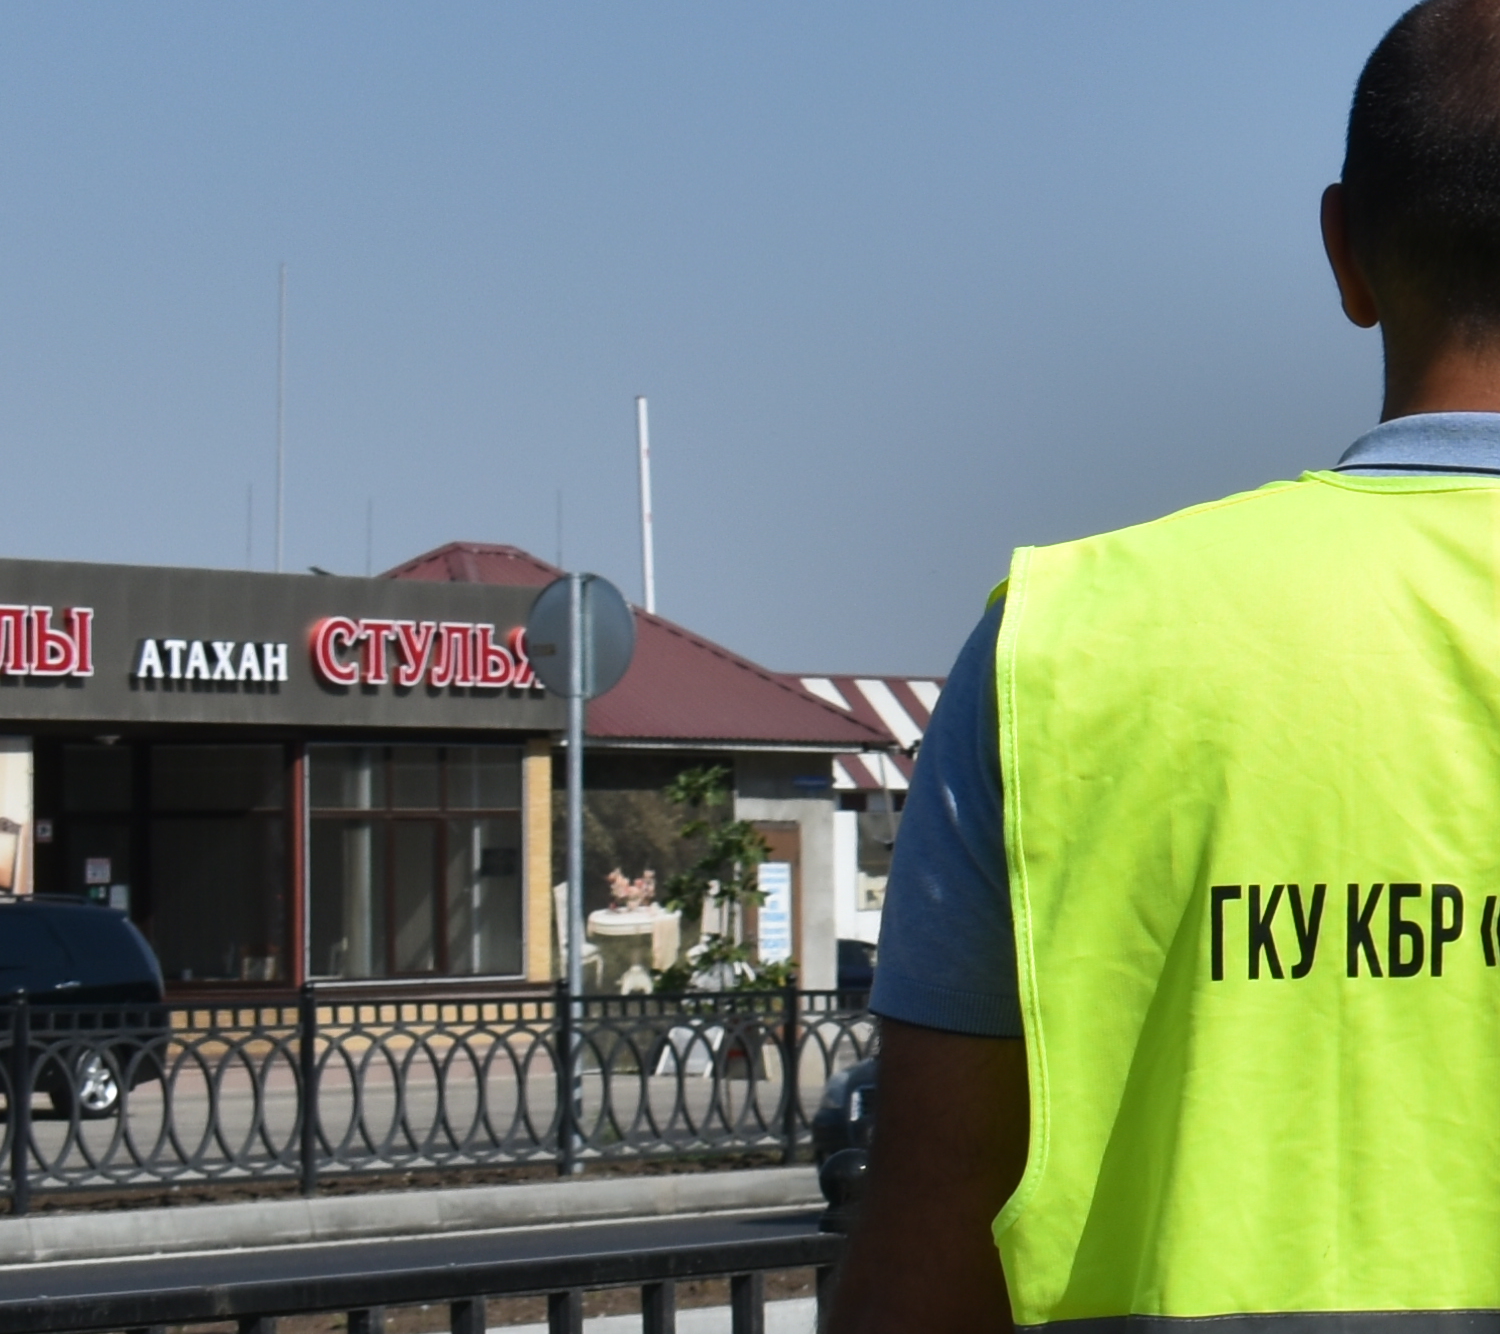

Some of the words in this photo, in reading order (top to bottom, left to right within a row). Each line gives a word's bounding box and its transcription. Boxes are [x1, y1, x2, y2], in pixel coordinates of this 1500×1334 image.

[137, 638, 289, 682] АТАХАН
[1210, 882, 1327, 981] ГКУ
[1345, 882, 1464, 979] КБР
